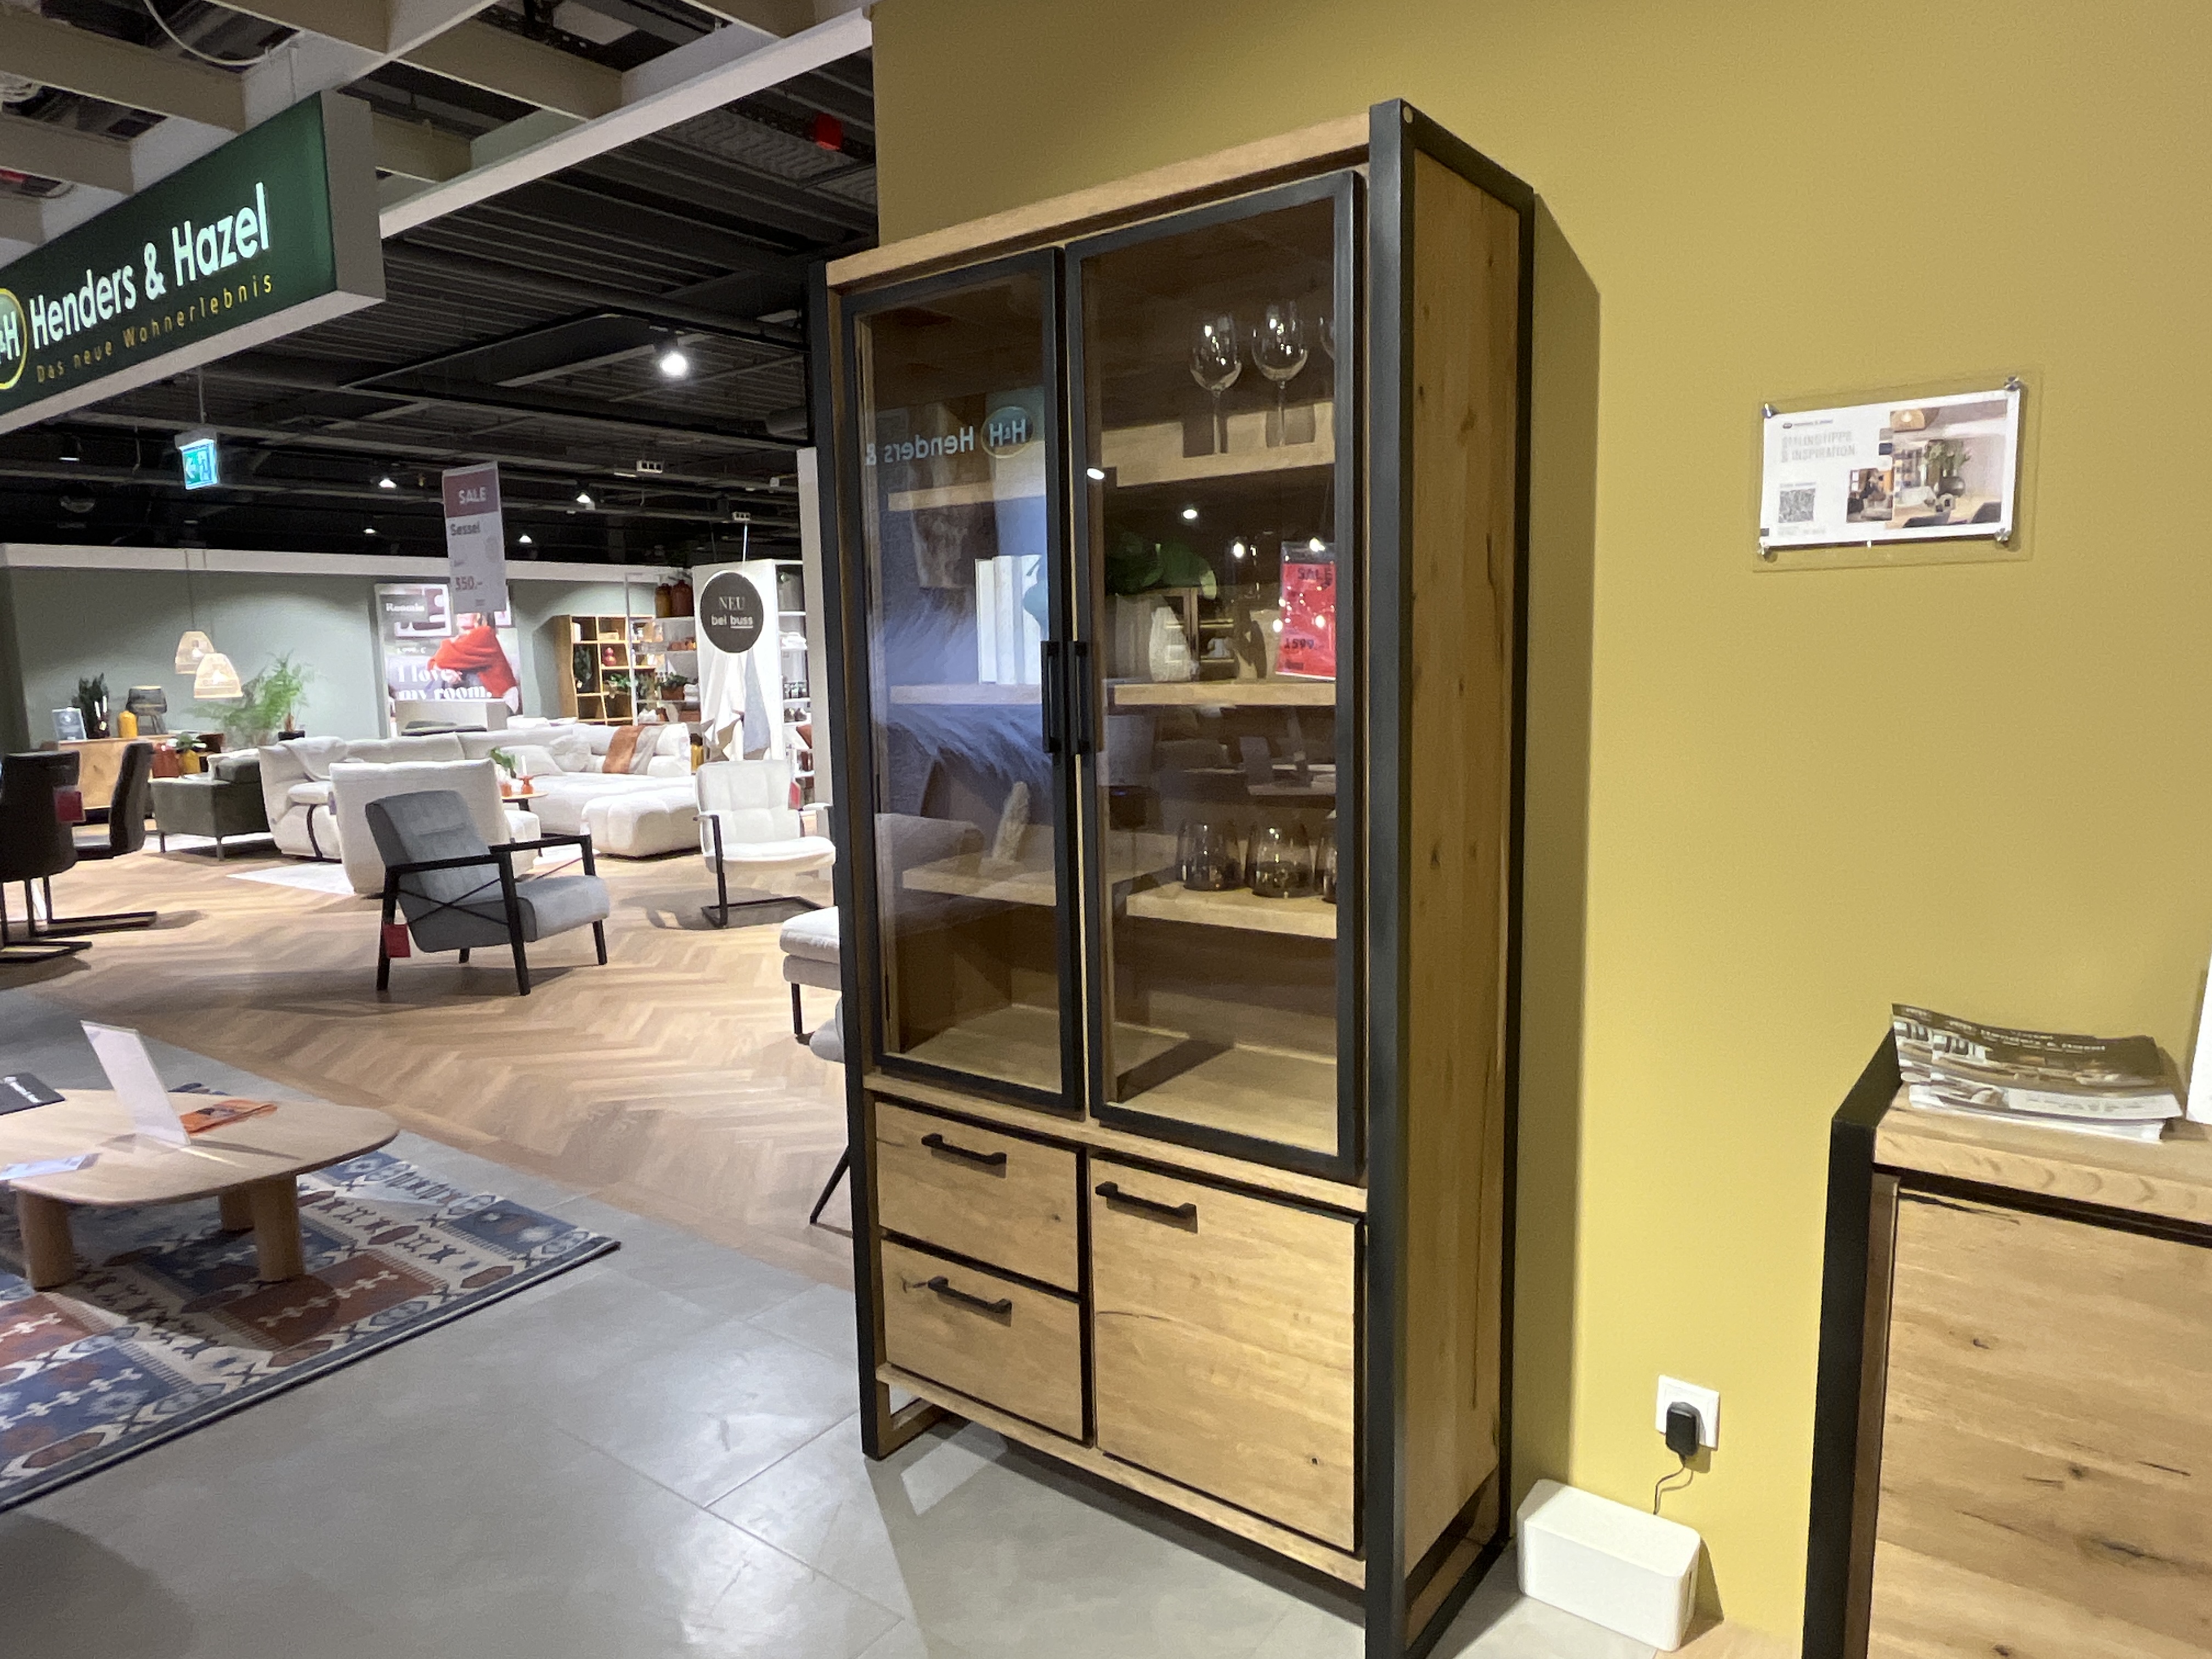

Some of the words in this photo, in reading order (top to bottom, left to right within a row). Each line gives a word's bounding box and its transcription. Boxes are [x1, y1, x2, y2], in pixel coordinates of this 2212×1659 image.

[29, 265, 137, 350] Henders
[144, 242, 166, 300] &
[171, 182, 270, 286] Hazel
[36, 360, 65, 383] Das
[73, 341, 112, 369] neue
[122, 274, 272, 348] Wohnerlebnis
[459, 486, 487, 505] SALE
[450, 522, 481, 535] Sessel
[719, 596, 745, 611] NEU
[711, 614, 727, 625] bei
[730, 614, 753, 627] buss
[398, 665, 405, 682] I
[434, 686, 493, 701] room.
